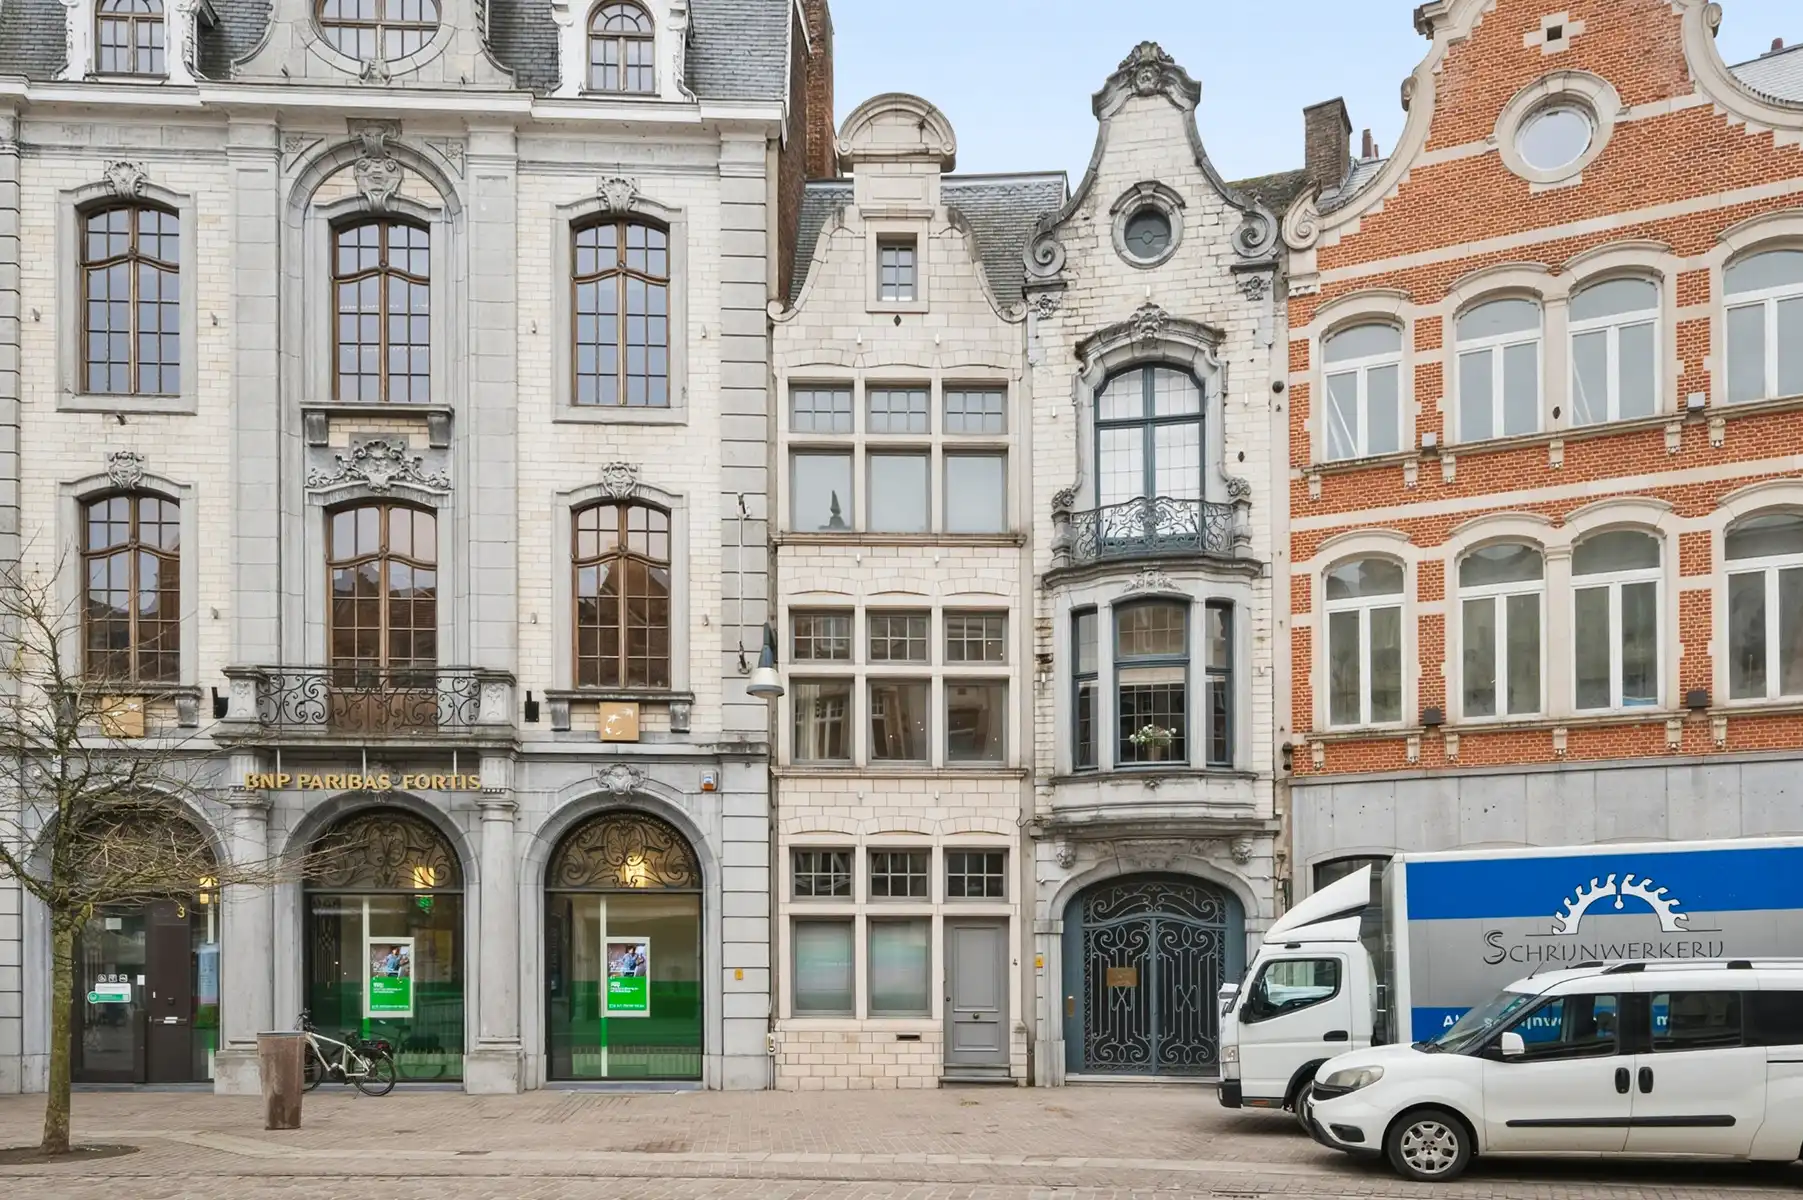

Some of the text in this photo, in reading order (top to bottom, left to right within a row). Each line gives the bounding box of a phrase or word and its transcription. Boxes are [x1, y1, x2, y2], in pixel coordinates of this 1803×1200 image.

[245, 773, 482, 791] BNP PARIBAS FORTIS
[176, 905, 185, 919] 3
